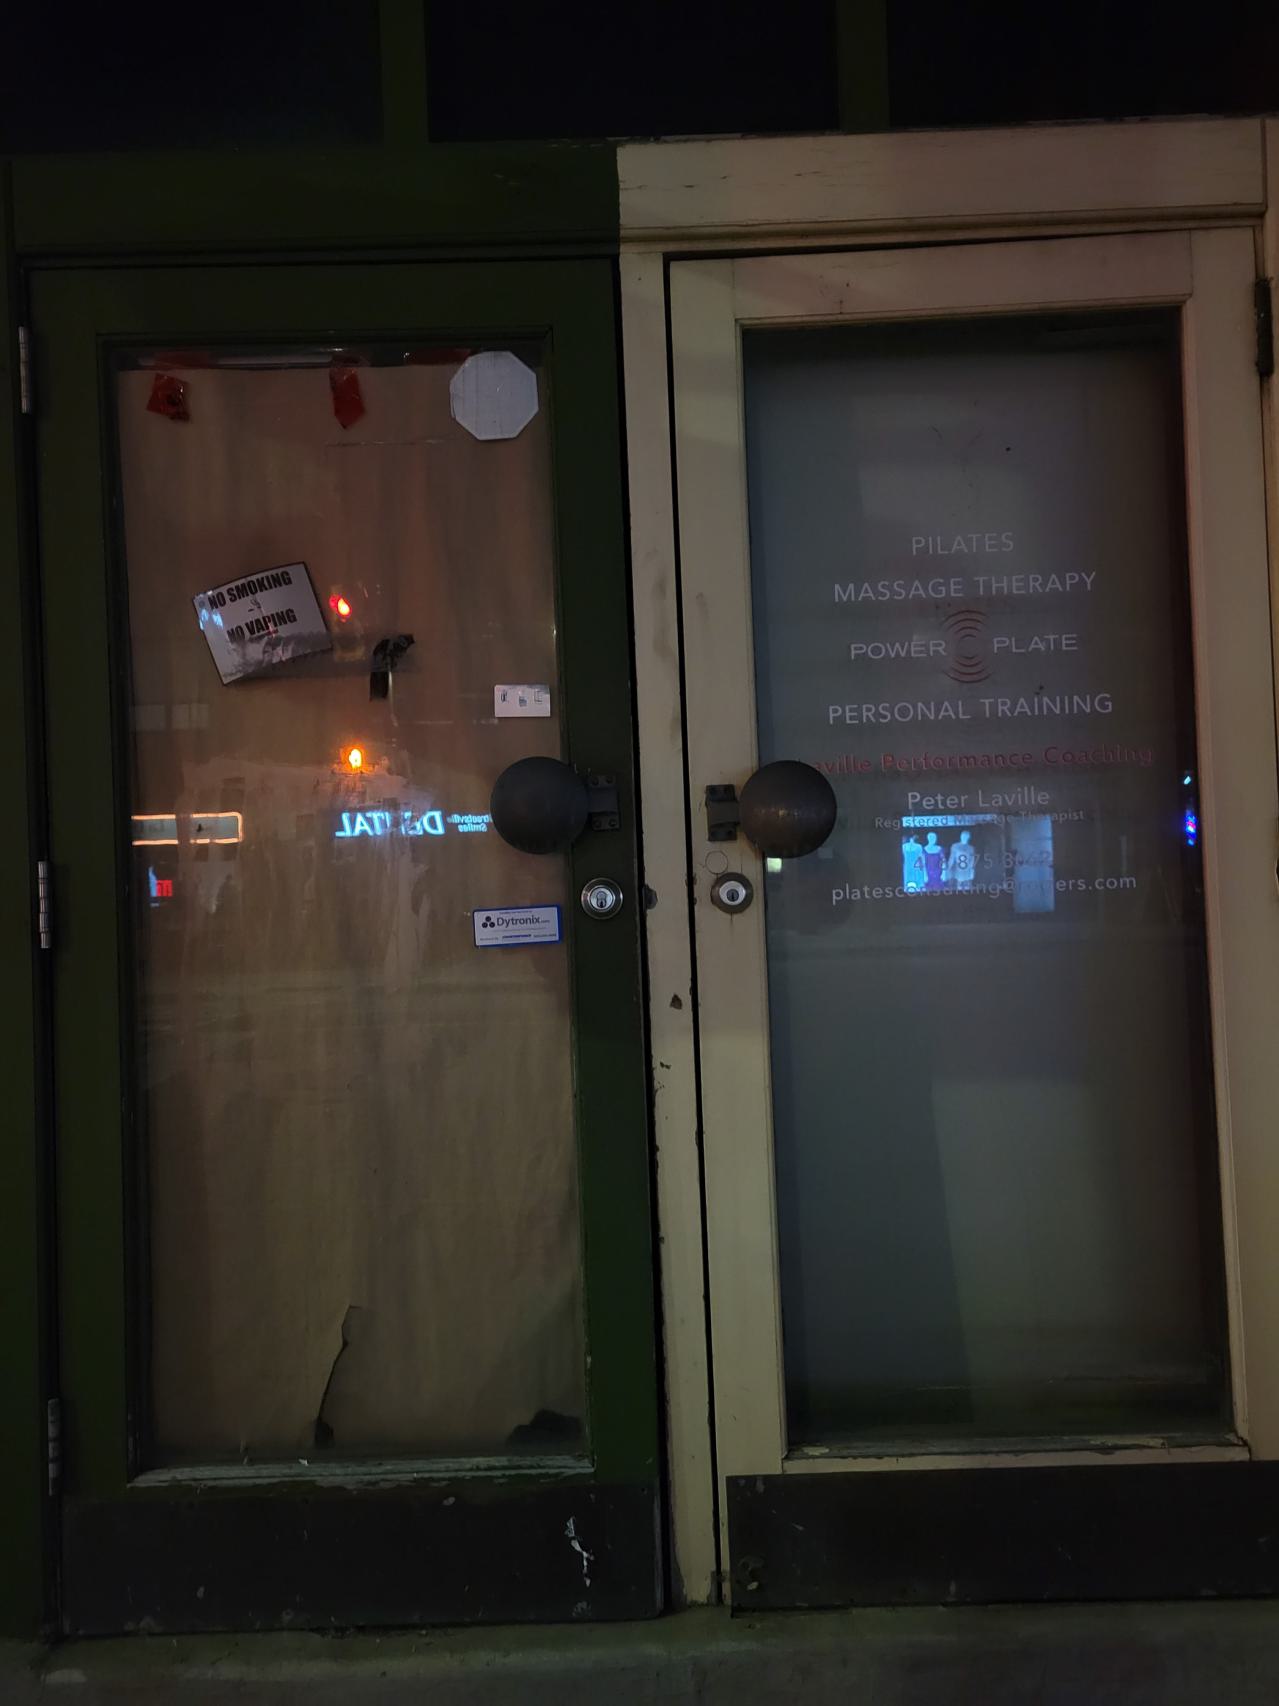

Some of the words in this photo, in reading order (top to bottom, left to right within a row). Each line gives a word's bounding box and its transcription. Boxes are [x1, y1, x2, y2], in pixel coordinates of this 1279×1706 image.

[912, 532, 1015, 556] PILATES
[208, 594, 226, 610] NO
[226, 570, 293, 603] SMOKING
[834, 578, 964, 602] MASSAGE
[973, 571, 1096, 596] THERAPY
[227, 626, 246, 644] NO
[245, 608, 298, 637] VAPING
[850, 640, 947, 660] POWER
[993, 634, 1078, 653] PLATE
[829, 702, 971, 725] PERSONAL
[980, 693, 1113, 718] TRAINING
[813, 753, 873, 775] aville
[880, 749, 1033, 772] Performance
[1043, 744, 1153, 767] Coaching
[907, 790, 969, 810] Peter
[979, 786, 1050, 807] Laville
[874, 816, 948, 830] Regstered
